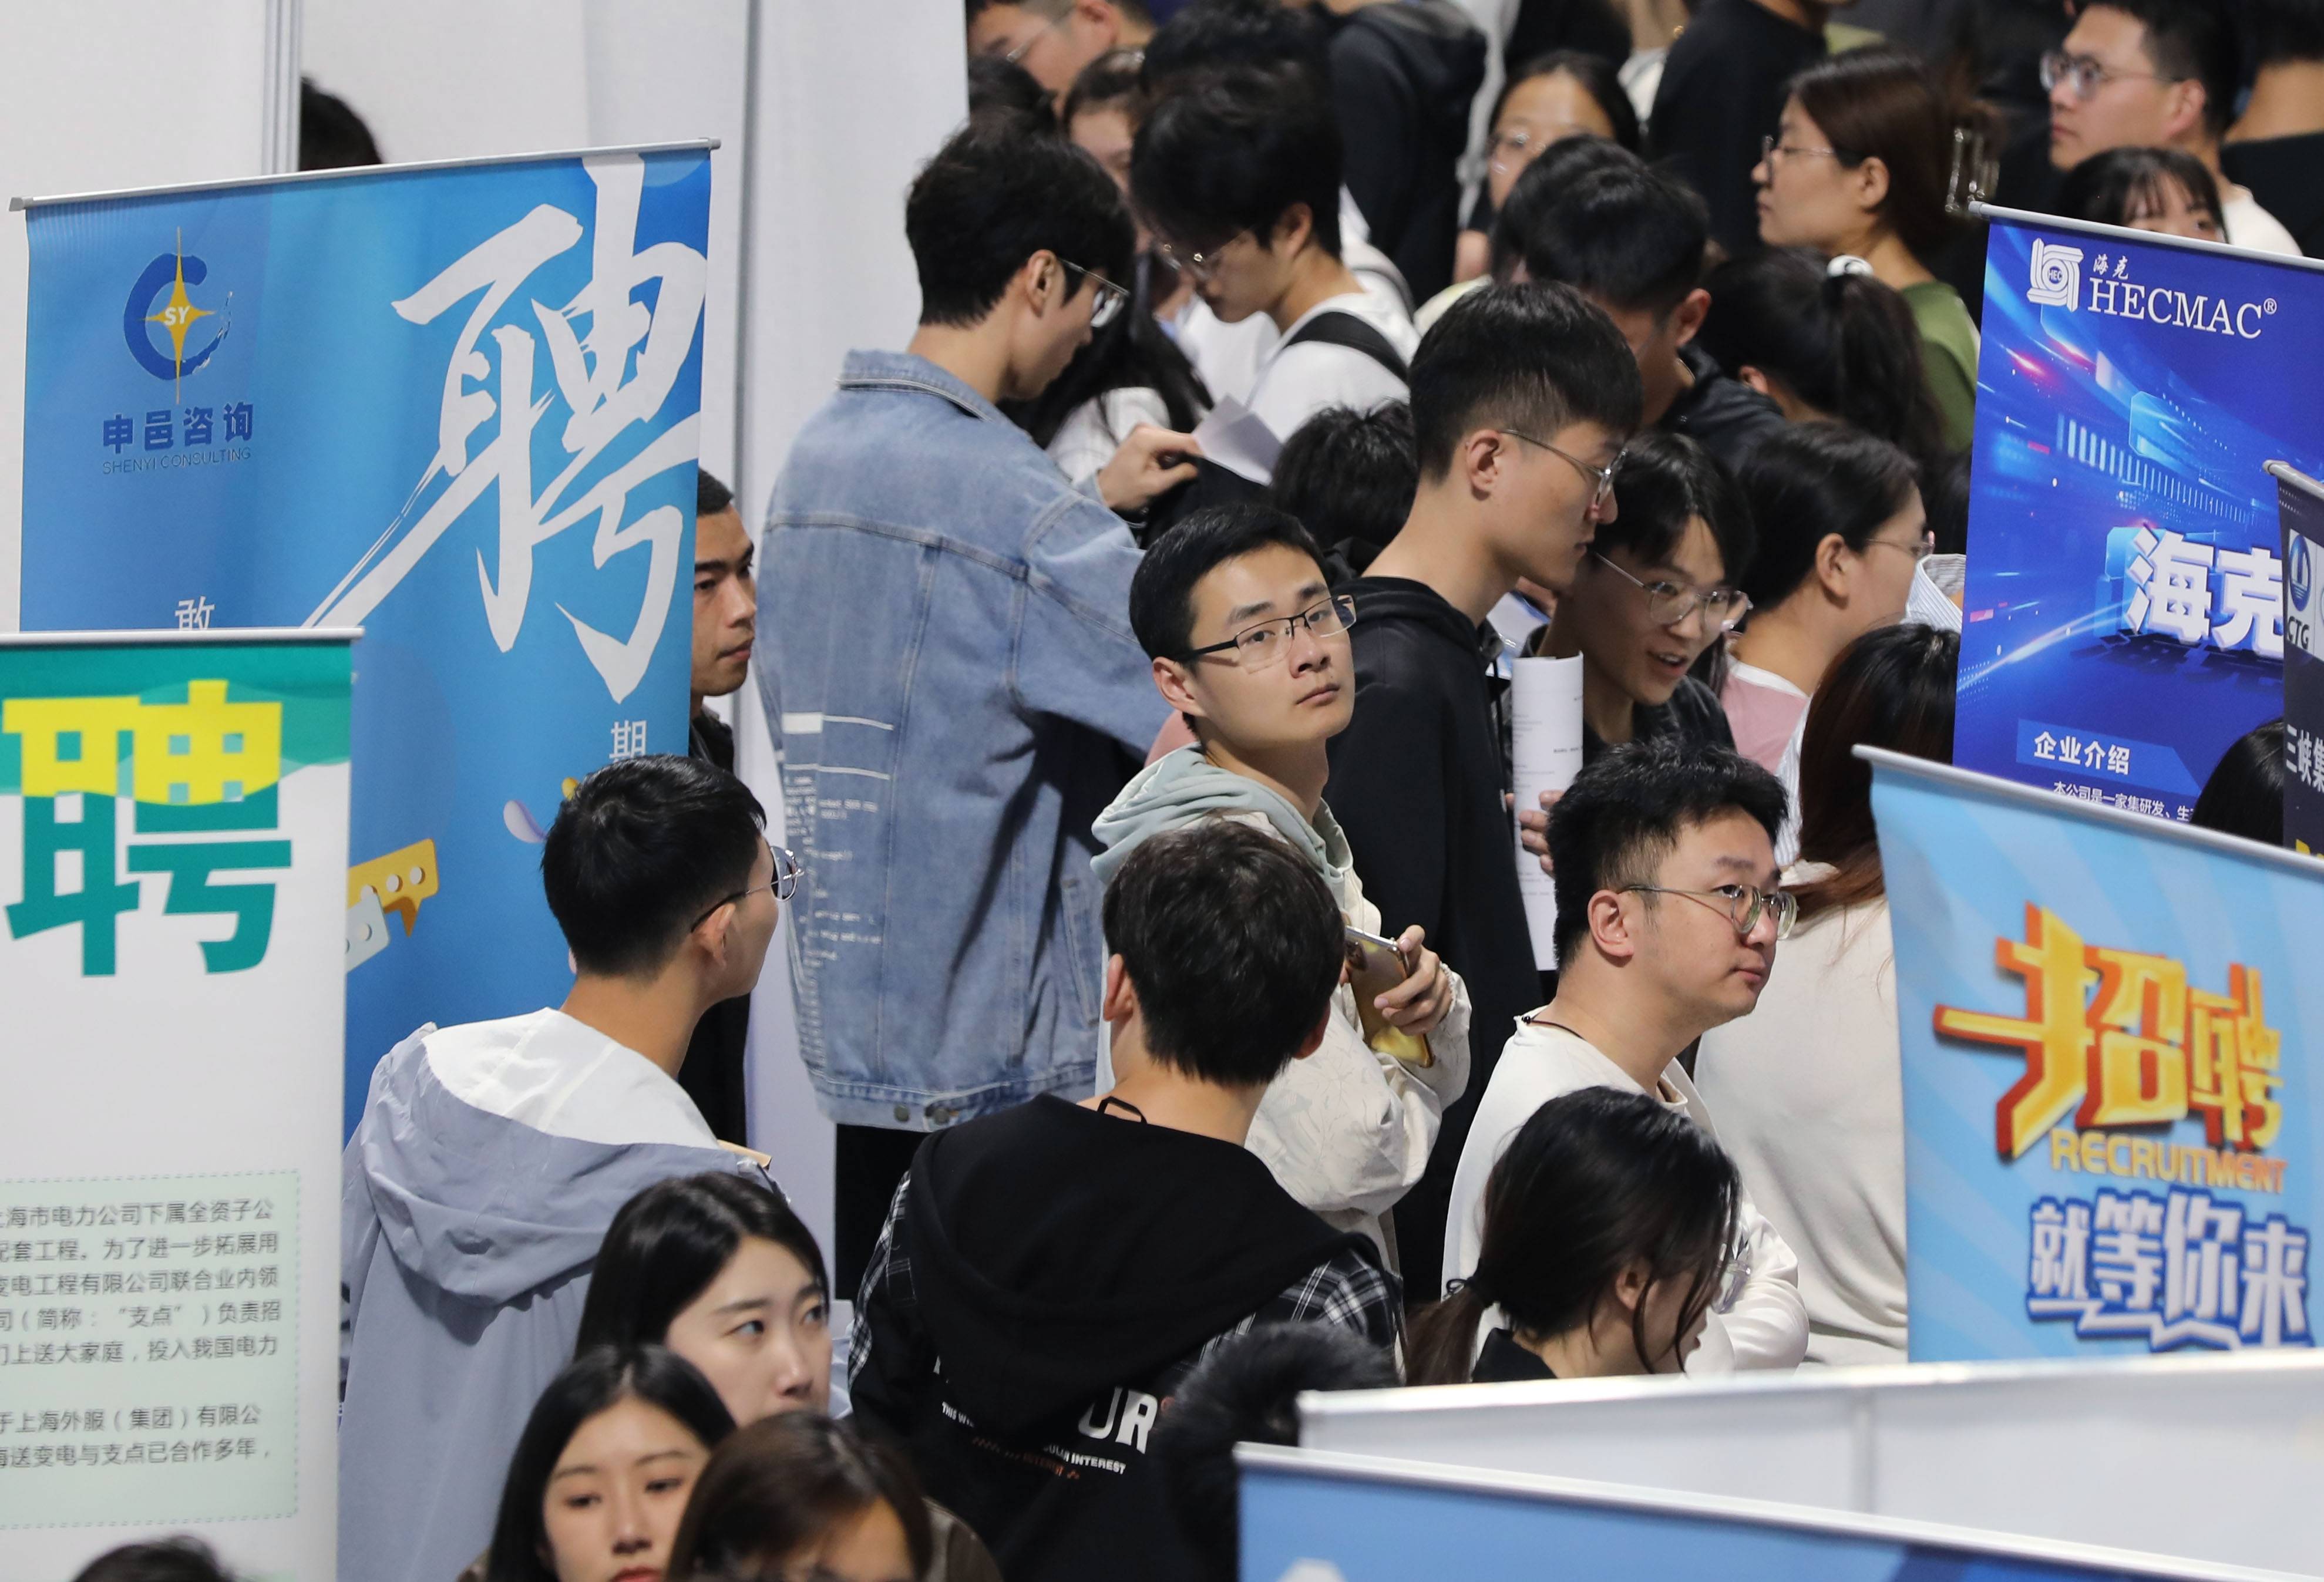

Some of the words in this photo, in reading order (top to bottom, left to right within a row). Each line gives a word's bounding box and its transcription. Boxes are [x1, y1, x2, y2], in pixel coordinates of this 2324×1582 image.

[2093, 254, 2128, 280] 海克
[164, 305, 190, 326] SY
[103, 402, 254, 454] 申邑咨询
[303, 153, 707, 704] 聘
[103, 458, 156, 475] SHENYI
[160, 446, 251, 469] CONSULTING
[2126, 526, 2284, 659] 海克
[2286, 615, 2309, 650] CTG
[2033, 731, 2131, 776] 企业介绍
[2, 679, 292, 978] 聘
[2053, 780, 2197, 822] 本公司是一家集研发、生
[1933, 900, 2285, 1160] 招聘
[2050, 1127, 2288, 1194] RECRUITMENT
[2030, 1189, 2309, 1348] 就等你来
[941, 1401, 957, 1421] THIS
[1071, 1452, 1126, 1475] INTEREST
